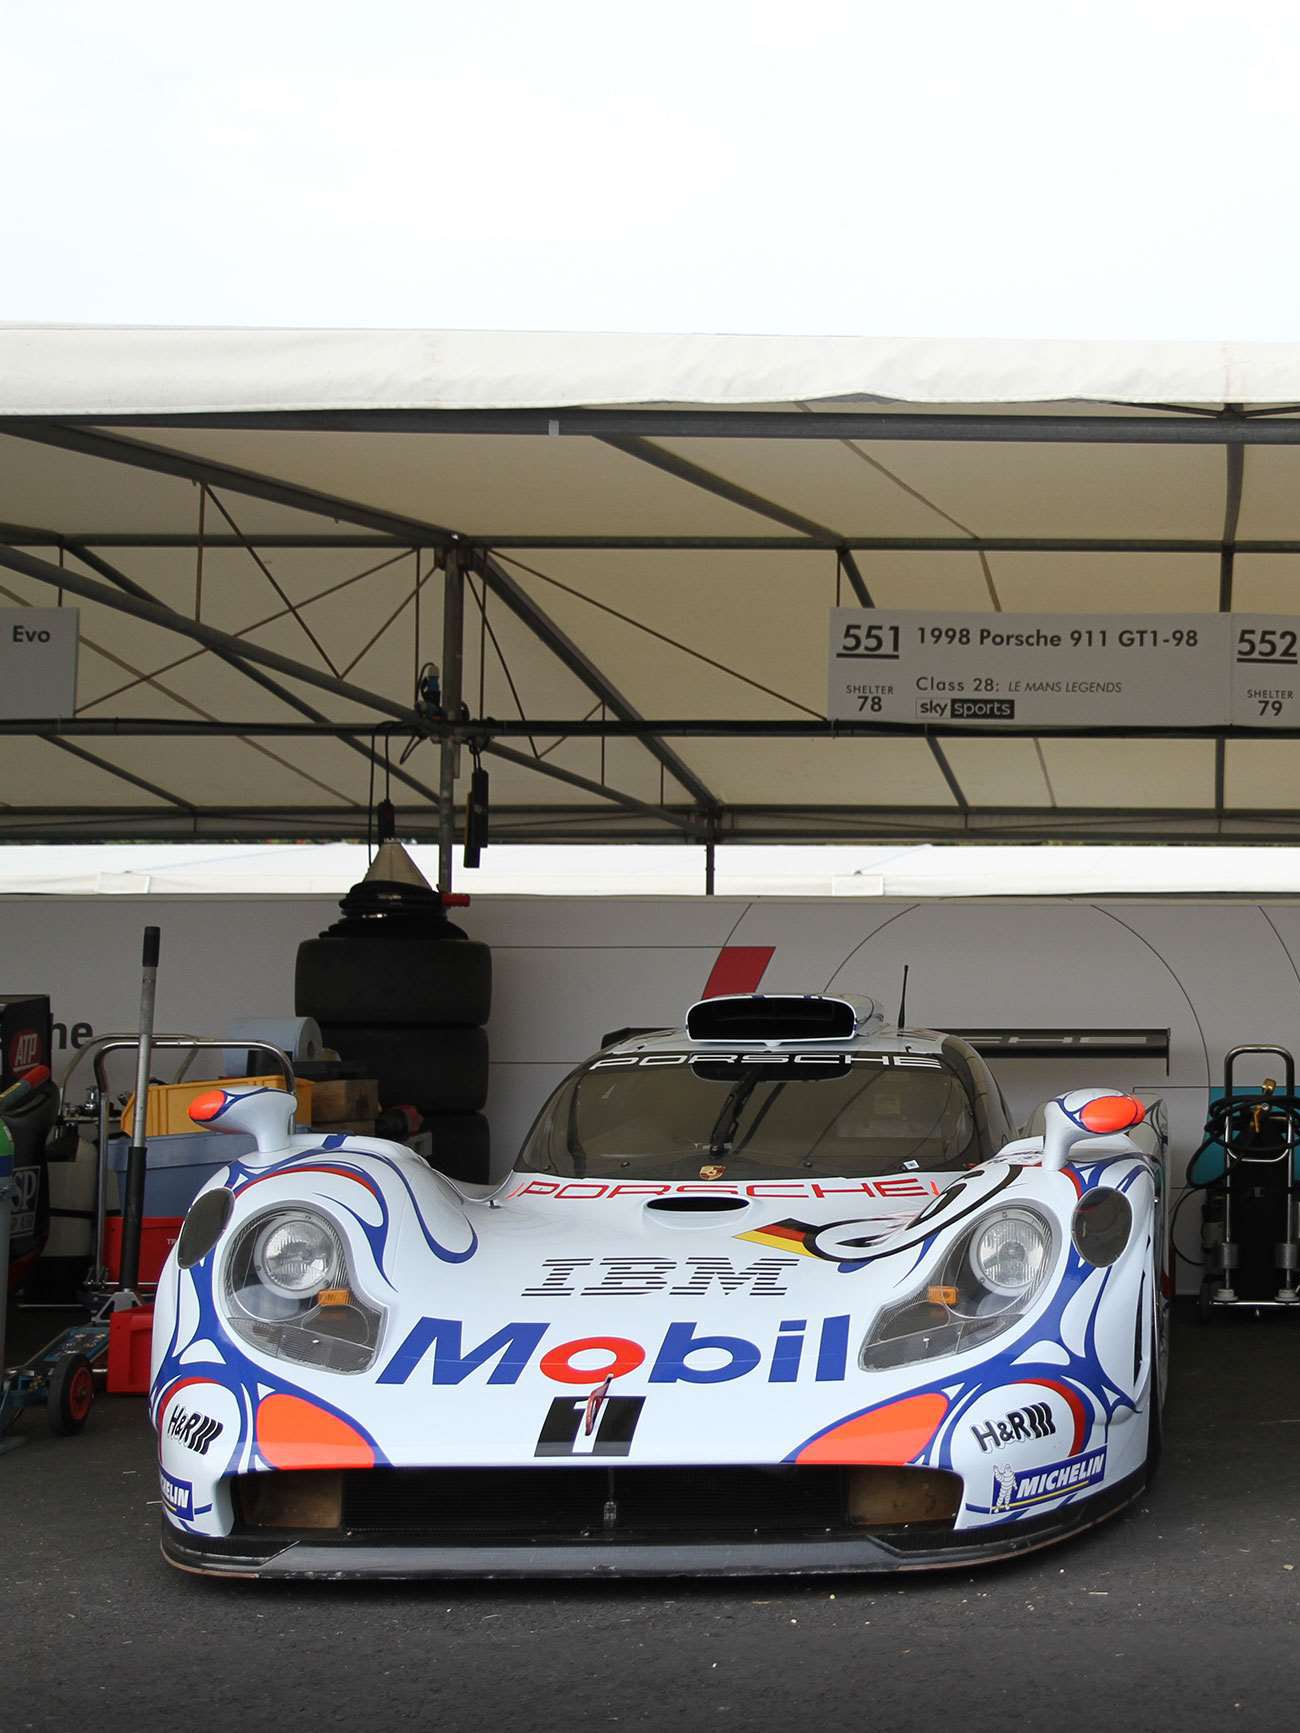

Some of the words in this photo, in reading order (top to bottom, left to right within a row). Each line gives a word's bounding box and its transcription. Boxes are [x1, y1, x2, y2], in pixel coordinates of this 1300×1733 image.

[12, 625, 51, 643] Evo
[842, 624, 900, 653] 551
[917, 627, 971, 646] 1998
[979, 628, 1062, 648] Porsche
[1070, 629, 1107, 648] 911
[1118, 630, 1199, 648] GT1-98
[1237, 629, 1298, 658] 552
[846, 684, 894, 696] SHELTER
[916, 676, 968, 693] Class
[973, 677, 1001, 693] 28:
[1008, 680, 1022, 693] LE
[1023, 680, 1062, 693] MANS
[1064, 681, 1122, 694] LEGENDS
[1247, 688, 1294, 700] SHELTER
[856, 696, 883, 713] 78
[920, 699, 948, 718] sky
[952, 700, 1011, 717] sports
[1257, 700, 1283, 717] 79
[589, 1053, 943, 1071] PORSCHE
[517, 1178, 927, 1199] PORSCHE
[521, 1257, 800, 1297] IBM
[375, 1314, 850, 1385] Mobil
[1016, 1453, 1105, 1500] MICHELIN
